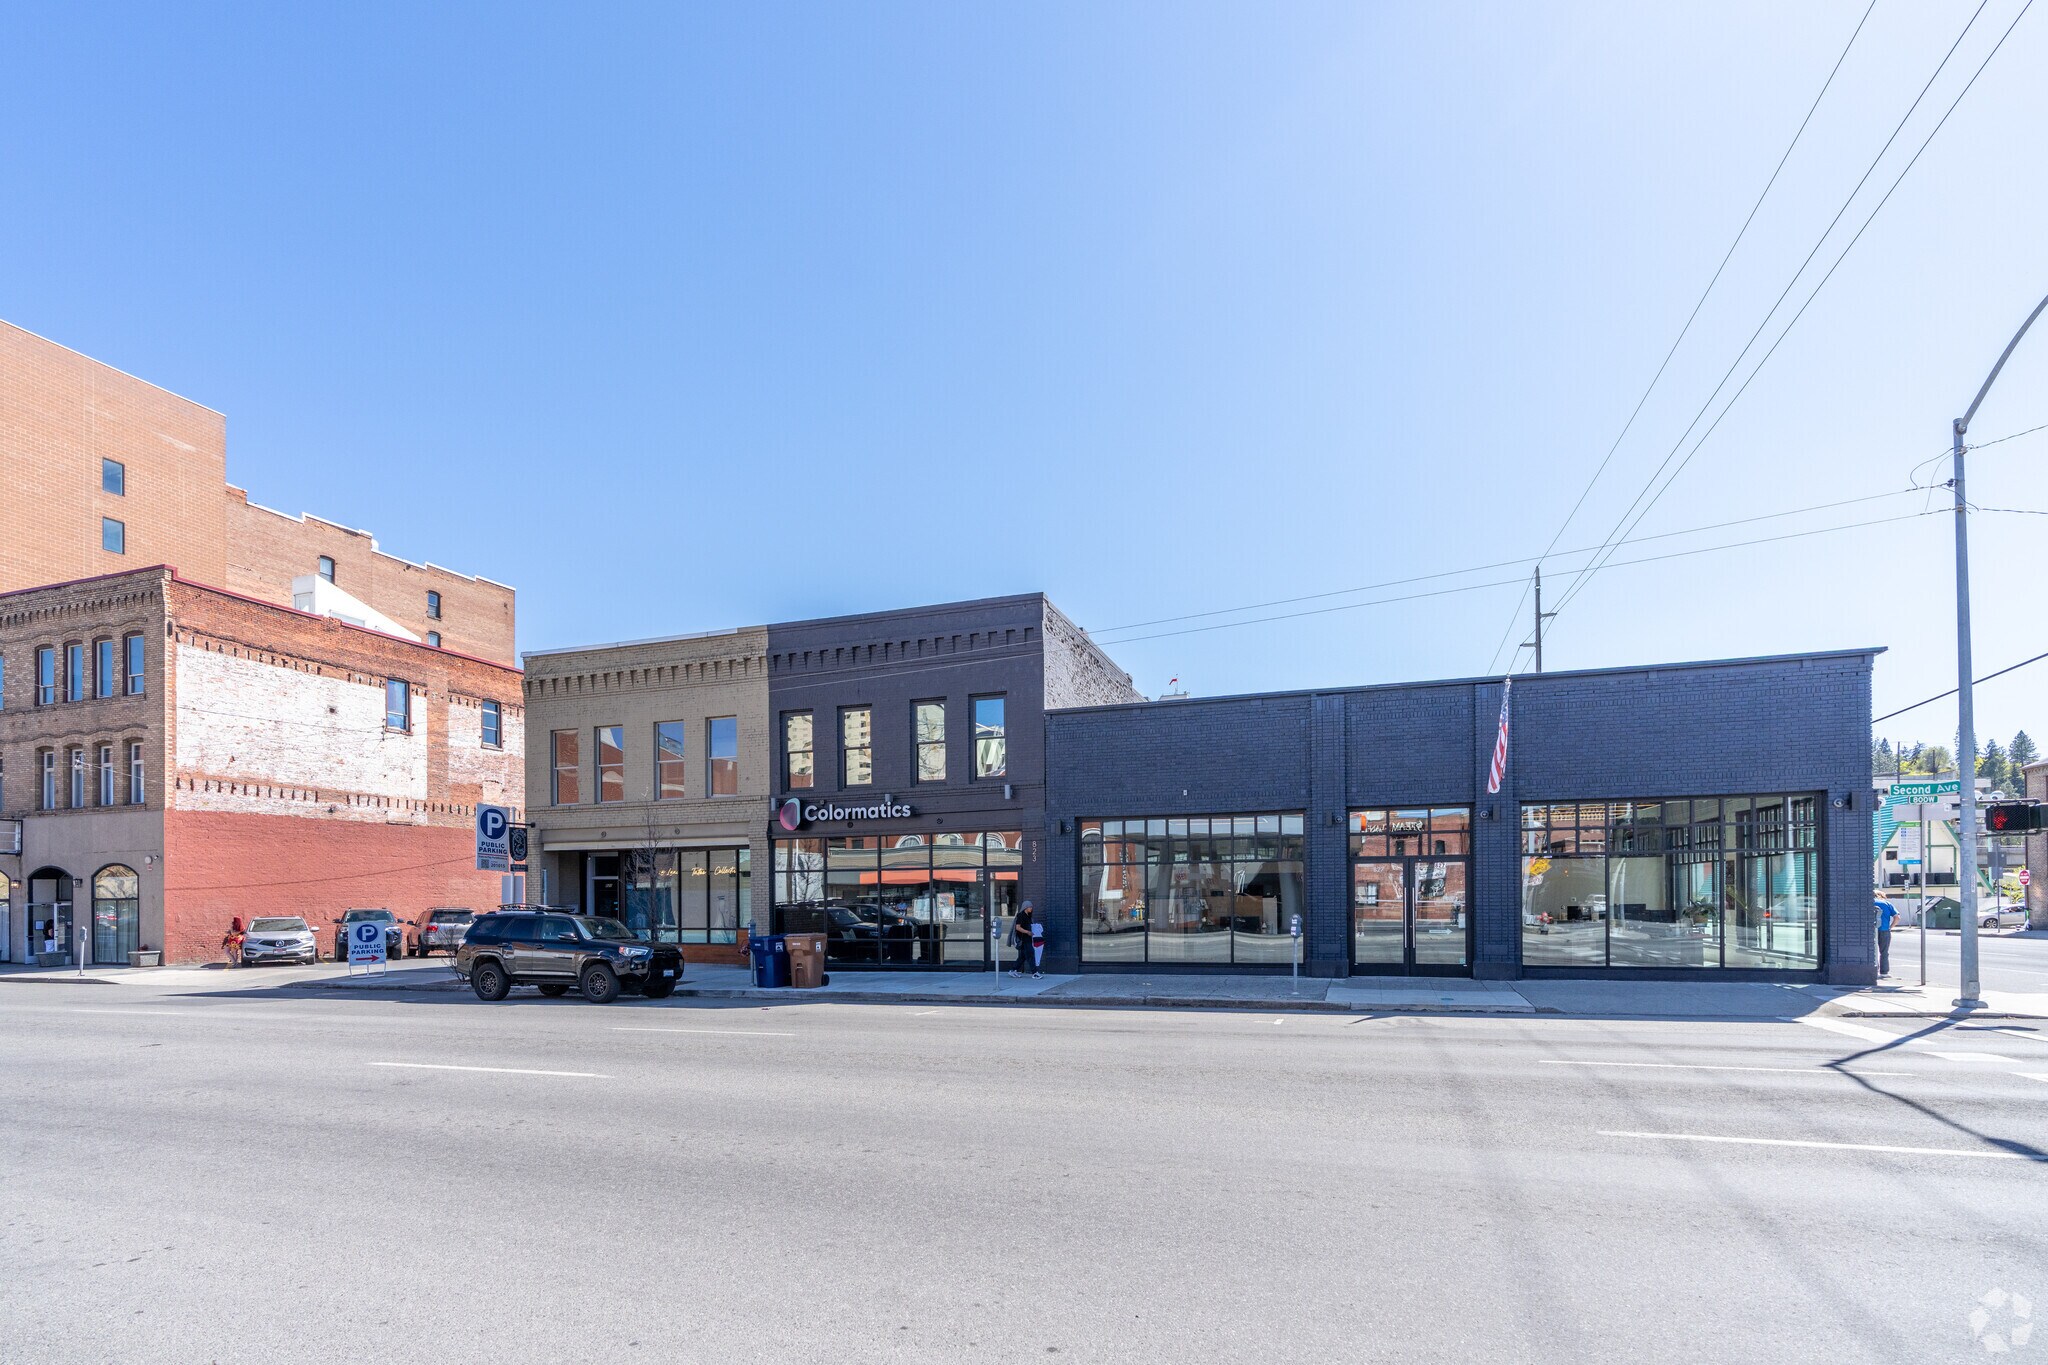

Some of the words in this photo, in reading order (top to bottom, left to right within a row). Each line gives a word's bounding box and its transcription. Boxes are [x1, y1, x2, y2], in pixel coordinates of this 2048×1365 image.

[1893, 785, 1931, 795] Second
[1936, 783, 1958, 793] Ave
[804, 801, 911, 821] Colormatics
[487, 812, 503, 836] P
[478, 846, 508, 855] PARKING
[481, 841, 505, 849] PUBLIC
[362, 927, 375, 941] P
